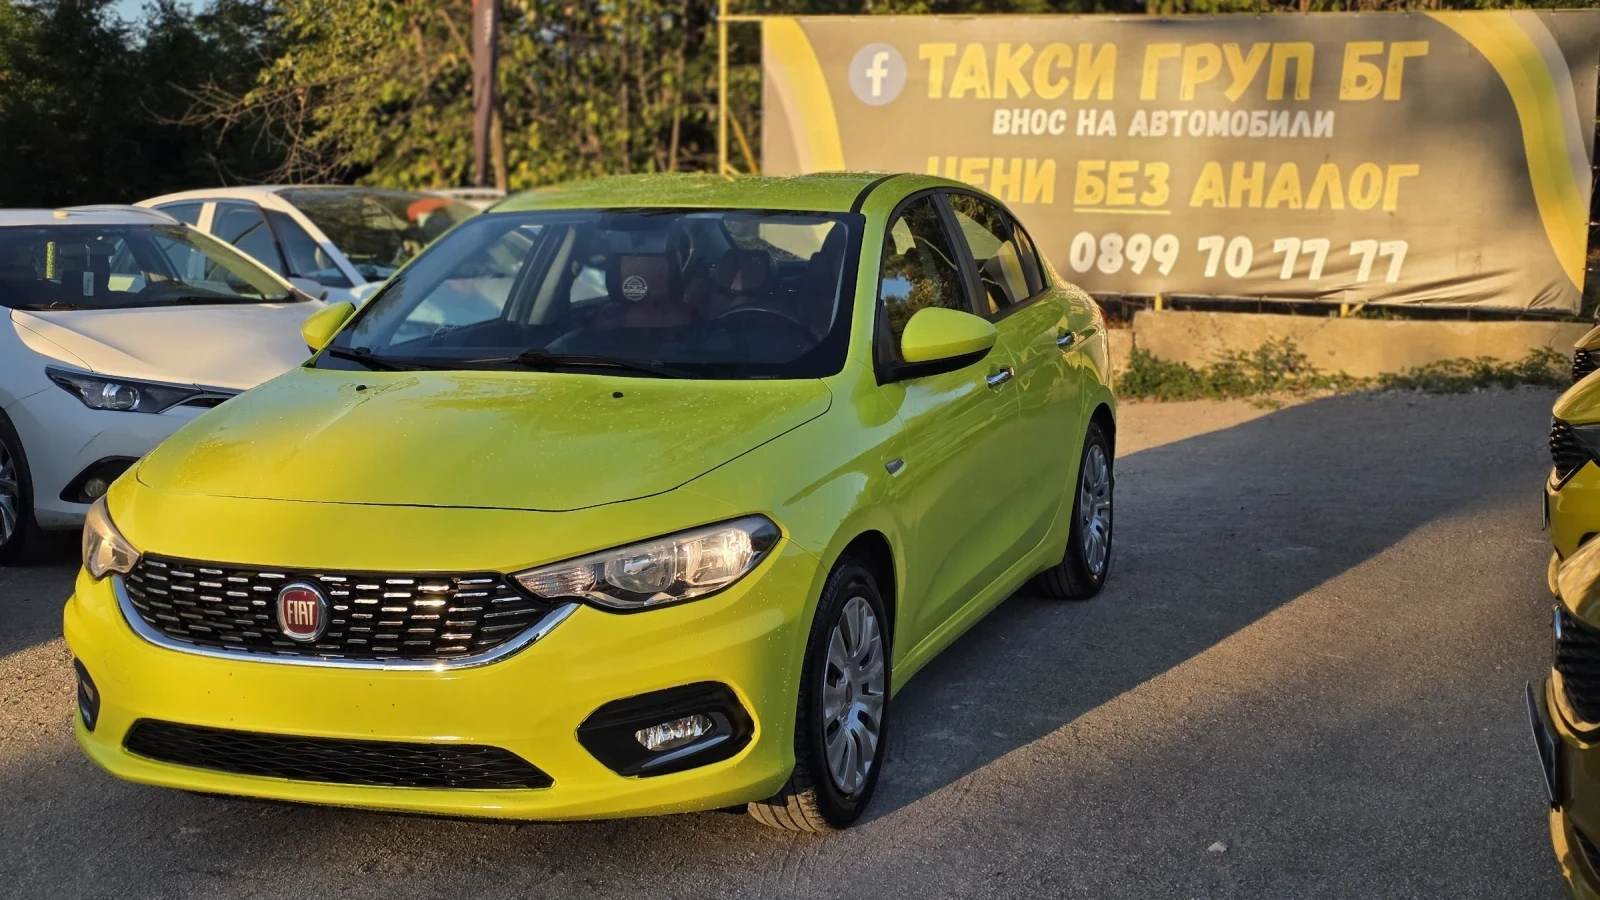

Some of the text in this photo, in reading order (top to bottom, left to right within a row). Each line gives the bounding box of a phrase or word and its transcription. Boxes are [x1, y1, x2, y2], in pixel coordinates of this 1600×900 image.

[919, 41, 1430, 102] ТАКСИ ГРУП БГ
[992, 108, 1336, 138] ВНОС НА АВТОМОБИЛИ
[1073, 160, 1171, 207] БЕЗ
[1189, 161, 1420, 212] АНАЛОГ
[1069, 231, 1409, 283] 0899 70 77 77
[287, 600, 316, 626] FIAT
